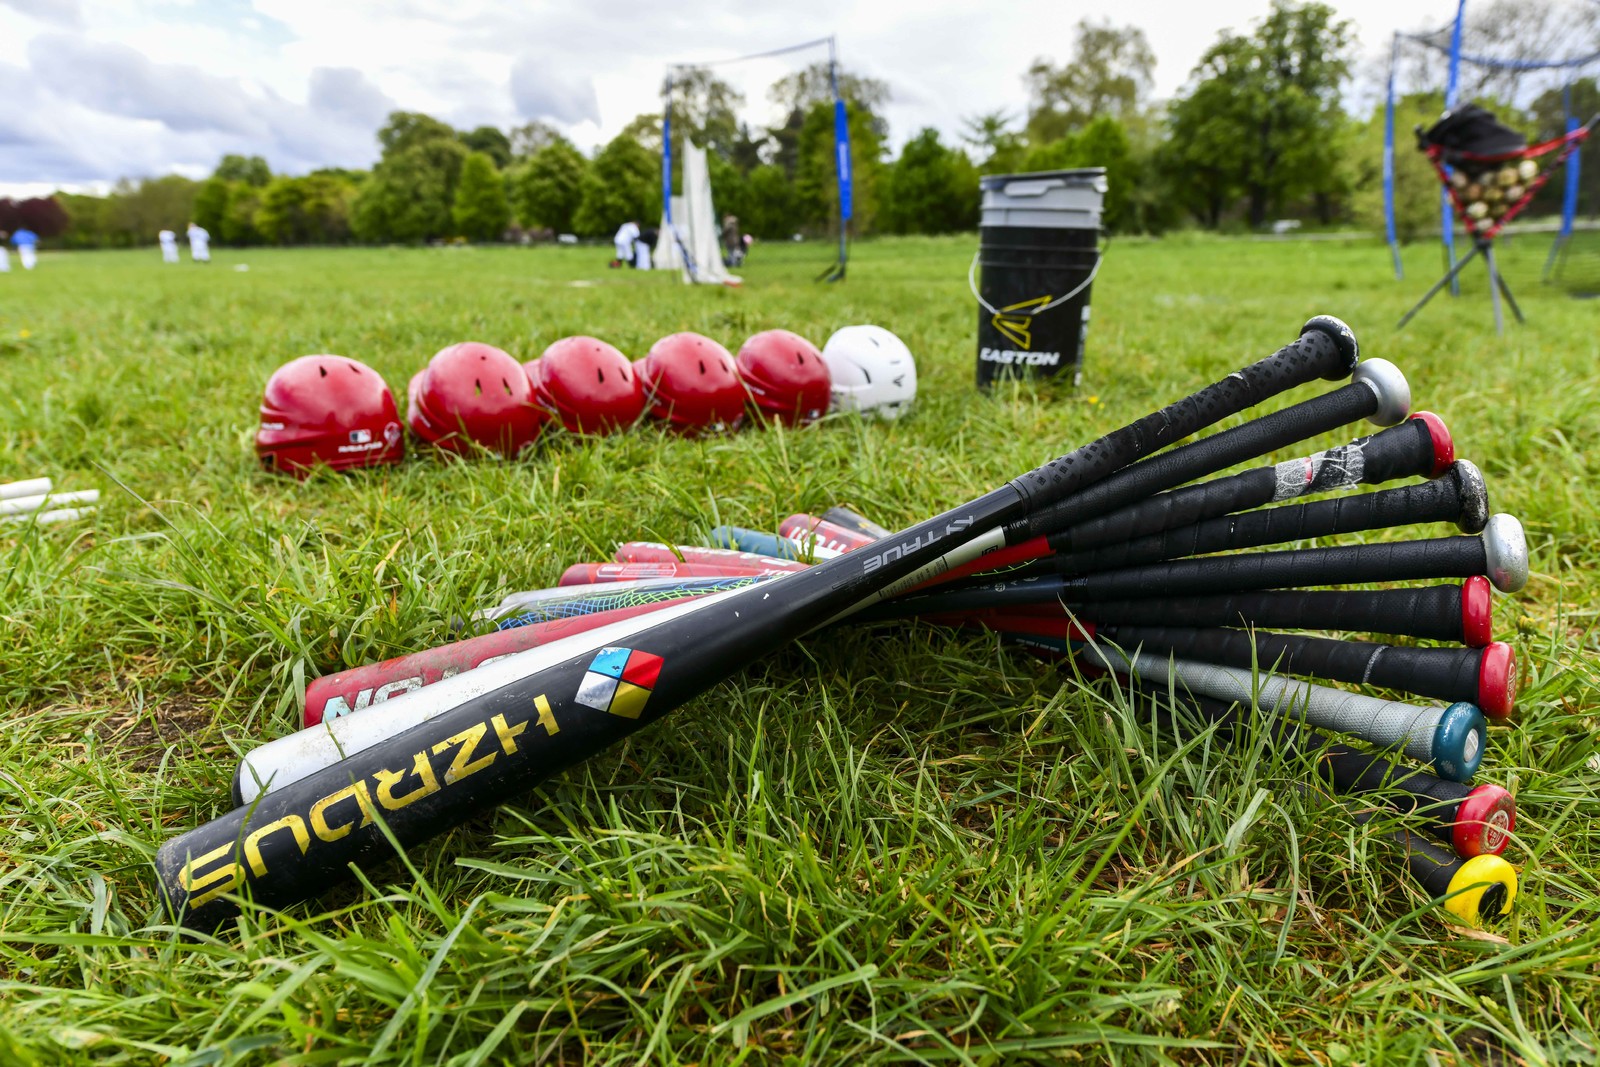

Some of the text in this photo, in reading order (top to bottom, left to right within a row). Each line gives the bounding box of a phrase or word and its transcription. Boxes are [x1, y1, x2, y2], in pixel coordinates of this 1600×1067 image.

[980, 347, 1060, 366] EASTON
[863, 530, 942, 575] TRUE
[178, 694, 560, 909] HZRDUS
